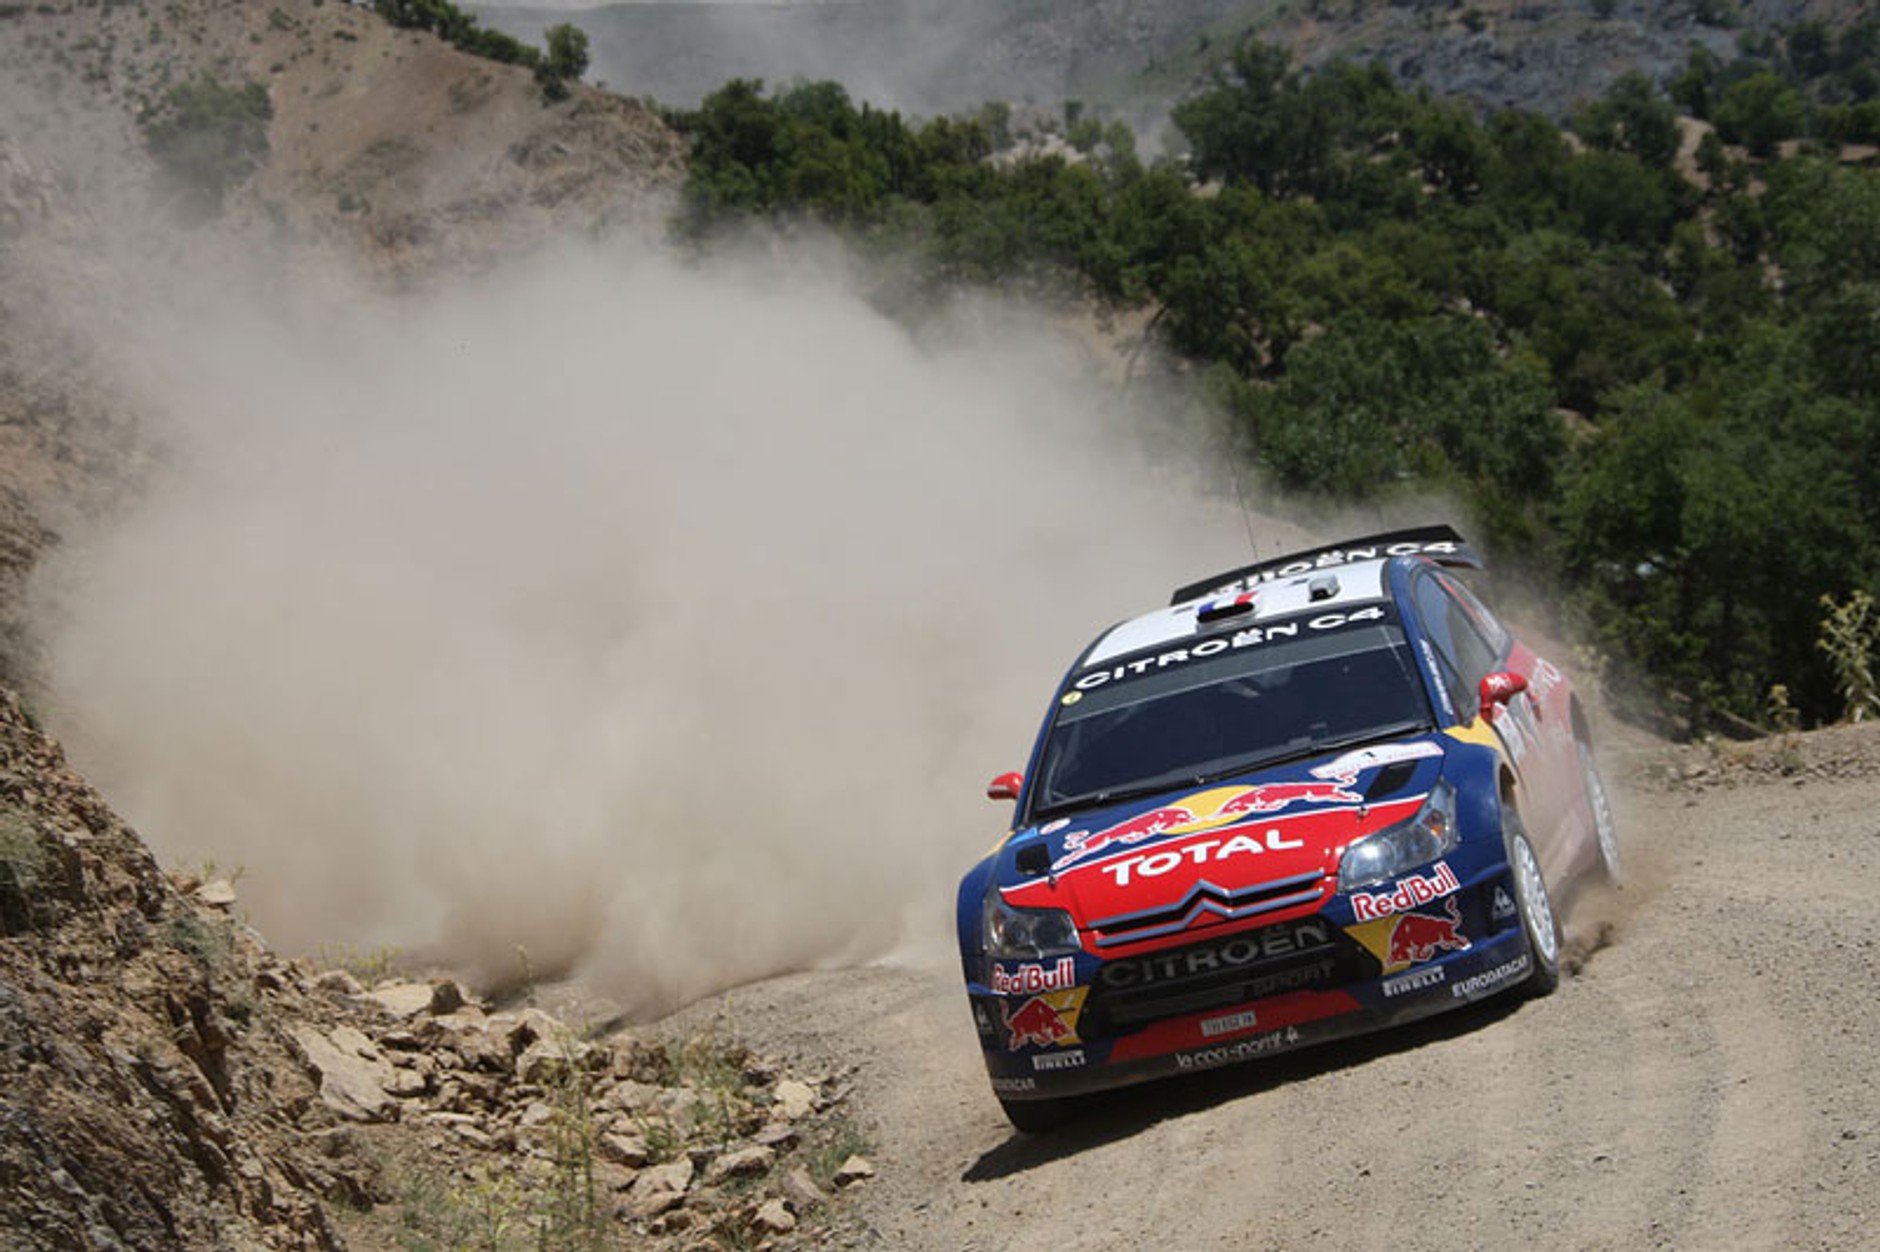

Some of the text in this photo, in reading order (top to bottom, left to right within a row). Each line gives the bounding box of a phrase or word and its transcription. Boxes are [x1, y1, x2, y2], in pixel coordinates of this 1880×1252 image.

[1387, 542, 1457, 556] C4
[1075, 606, 1386, 689] CITROËN C4
[1102, 829, 1304, 886] TOTAL
[1351, 861, 1460, 921] Red Bull
[993, 957, 1074, 993] Red Bull
[1102, 921, 1329, 987] CITROËN
[1382, 965, 1445, 997] PIRELLI
[1032, 1050, 1085, 1070] PIRELLI
